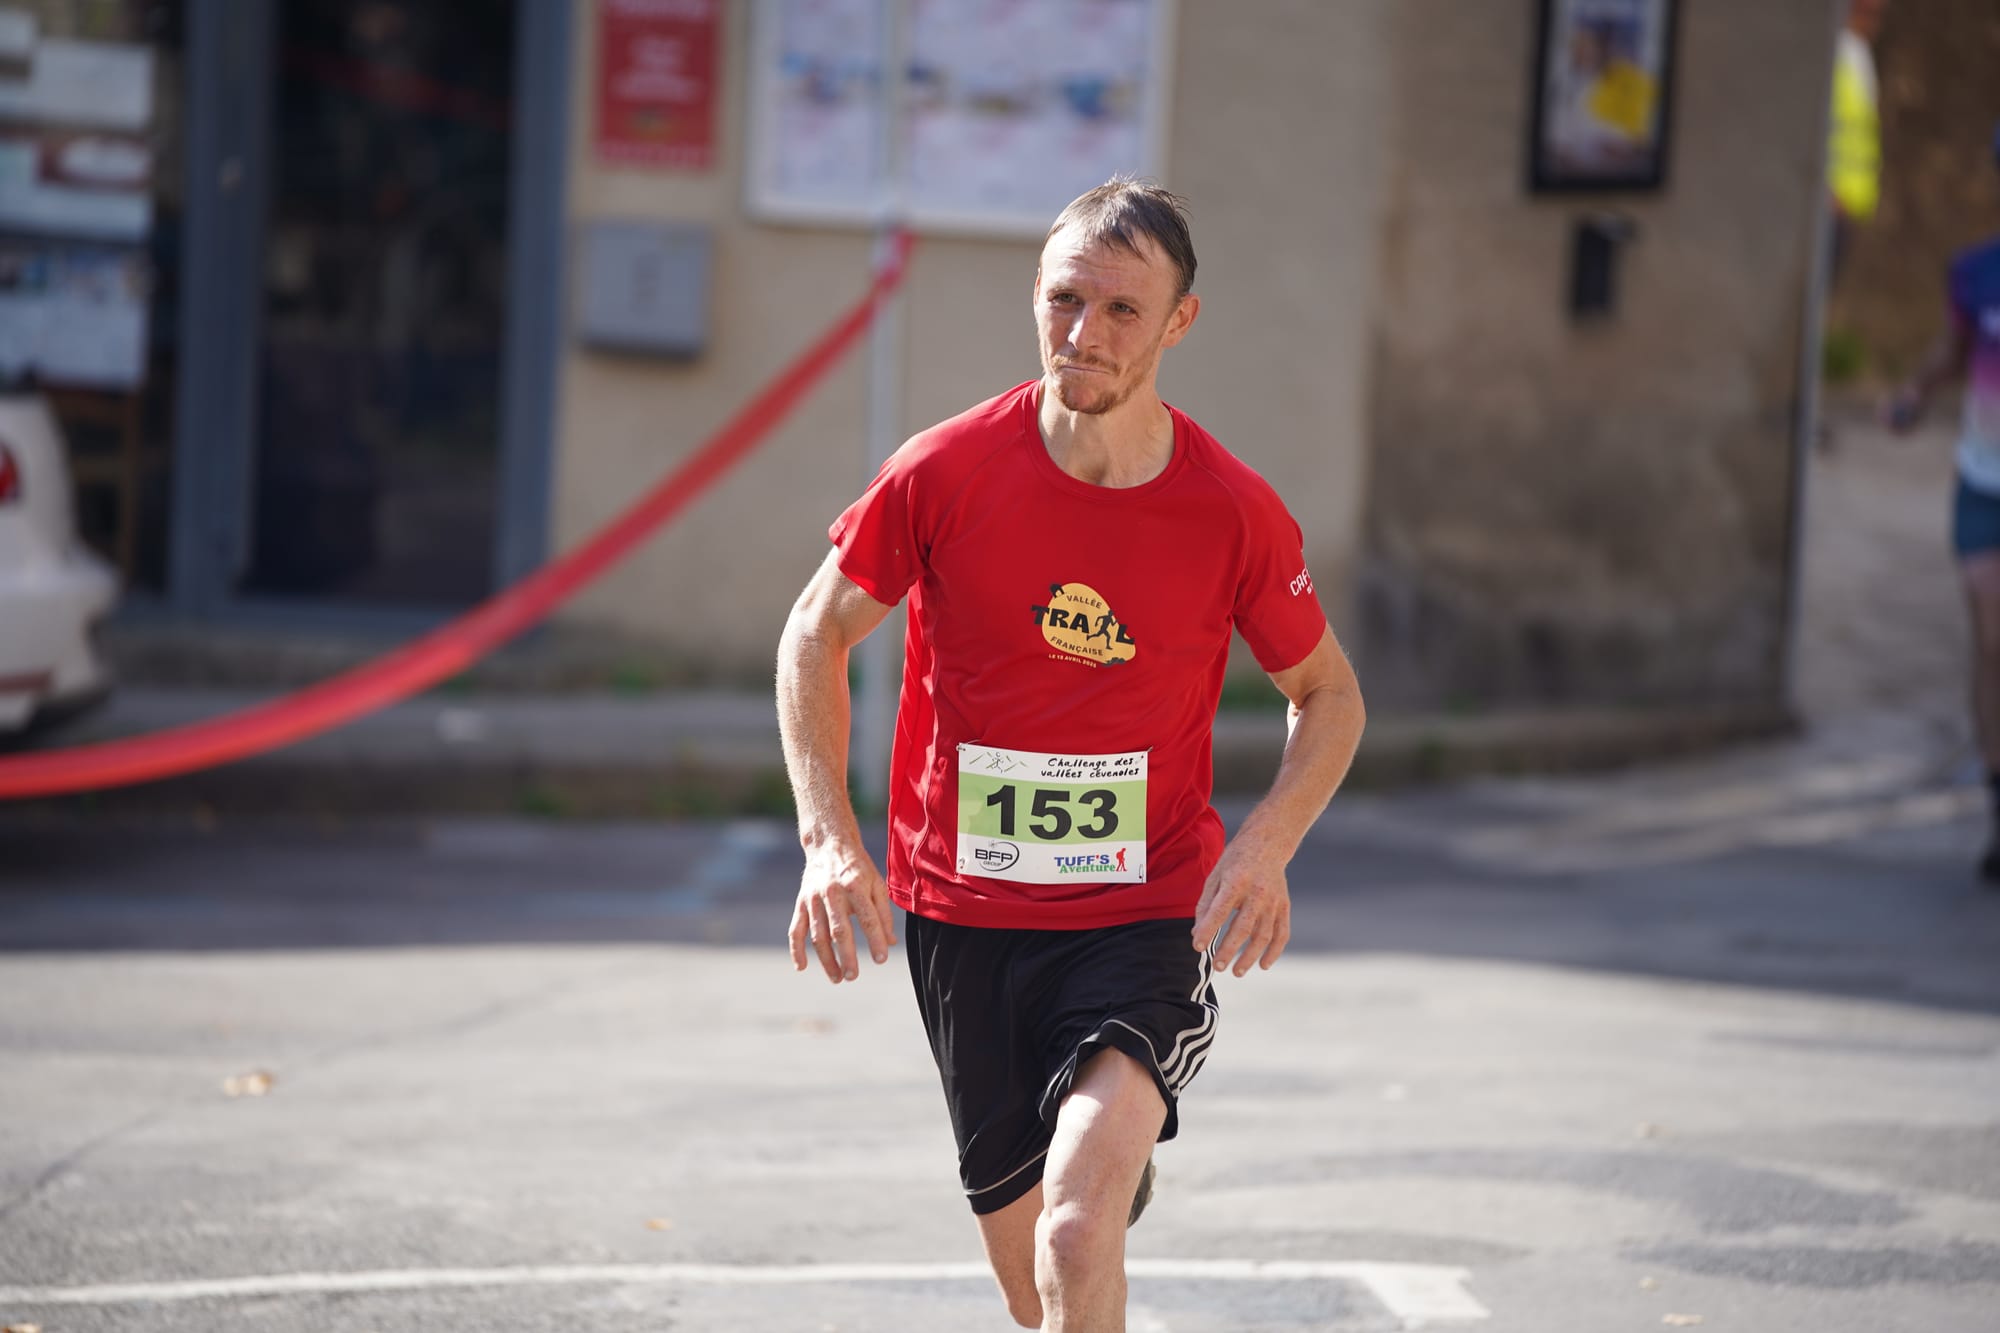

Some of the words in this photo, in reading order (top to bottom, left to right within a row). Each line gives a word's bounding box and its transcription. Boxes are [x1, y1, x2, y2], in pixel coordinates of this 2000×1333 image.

[1066, 595, 1102, 609] VALLÉE
[1050, 636, 1104, 656] FRANÇAISE
[1048, 757, 1107, 770] Challenge
[1114, 757, 1133, 766] des
[1041, 768, 1082, 778] vallées
[1089, 767, 1139, 778] cévenoles
[986, 784, 1119, 840] 153
[975, 848, 1013, 863] BFP
[1054, 854, 1110, 867] TUFF'S
[1059, 863, 1116, 874] Aventure
